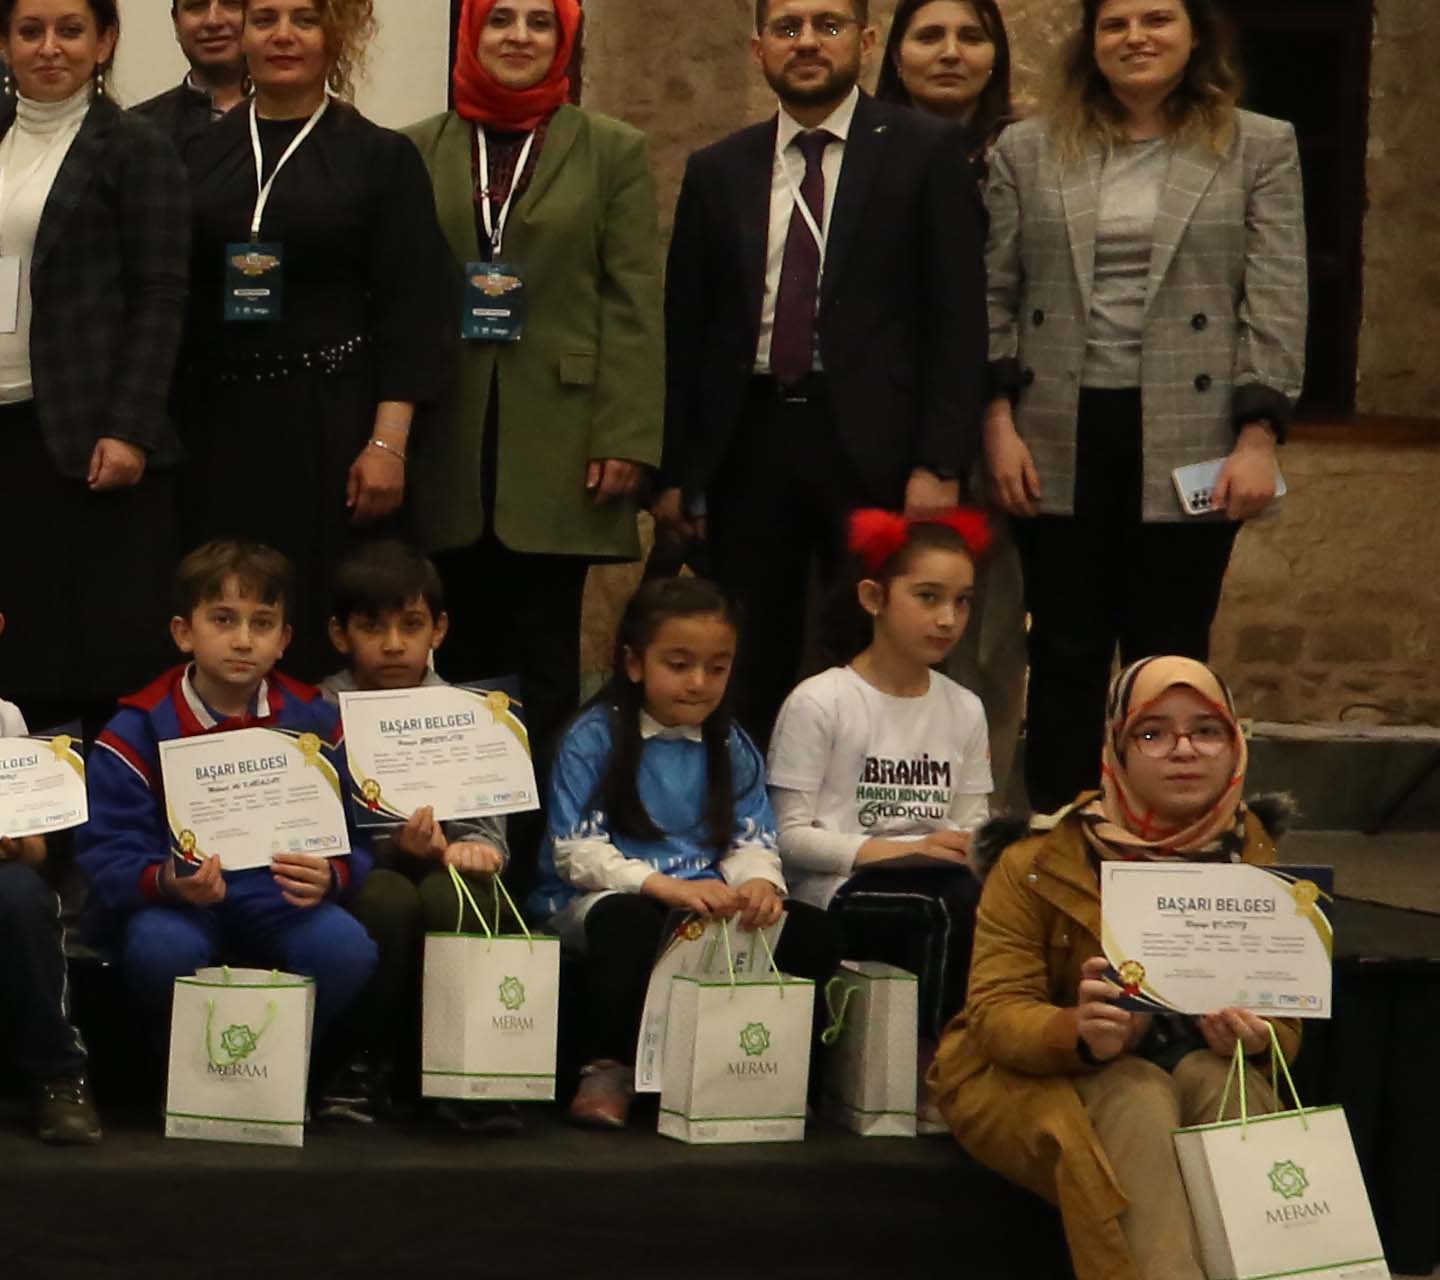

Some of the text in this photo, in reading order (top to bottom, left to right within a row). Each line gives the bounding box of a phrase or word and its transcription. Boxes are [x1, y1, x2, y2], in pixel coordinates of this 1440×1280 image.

[379, 711, 477, 734] BAŞARI BELGESİ
[195, 753, 289, 781] BAŞARI BELGESİ
[1156, 896, 1277, 914] BAŞARI BELGESİ
[726, 1061, 779, 1076] MERAM
[1265, 1200, 1332, 1225] MERAM
